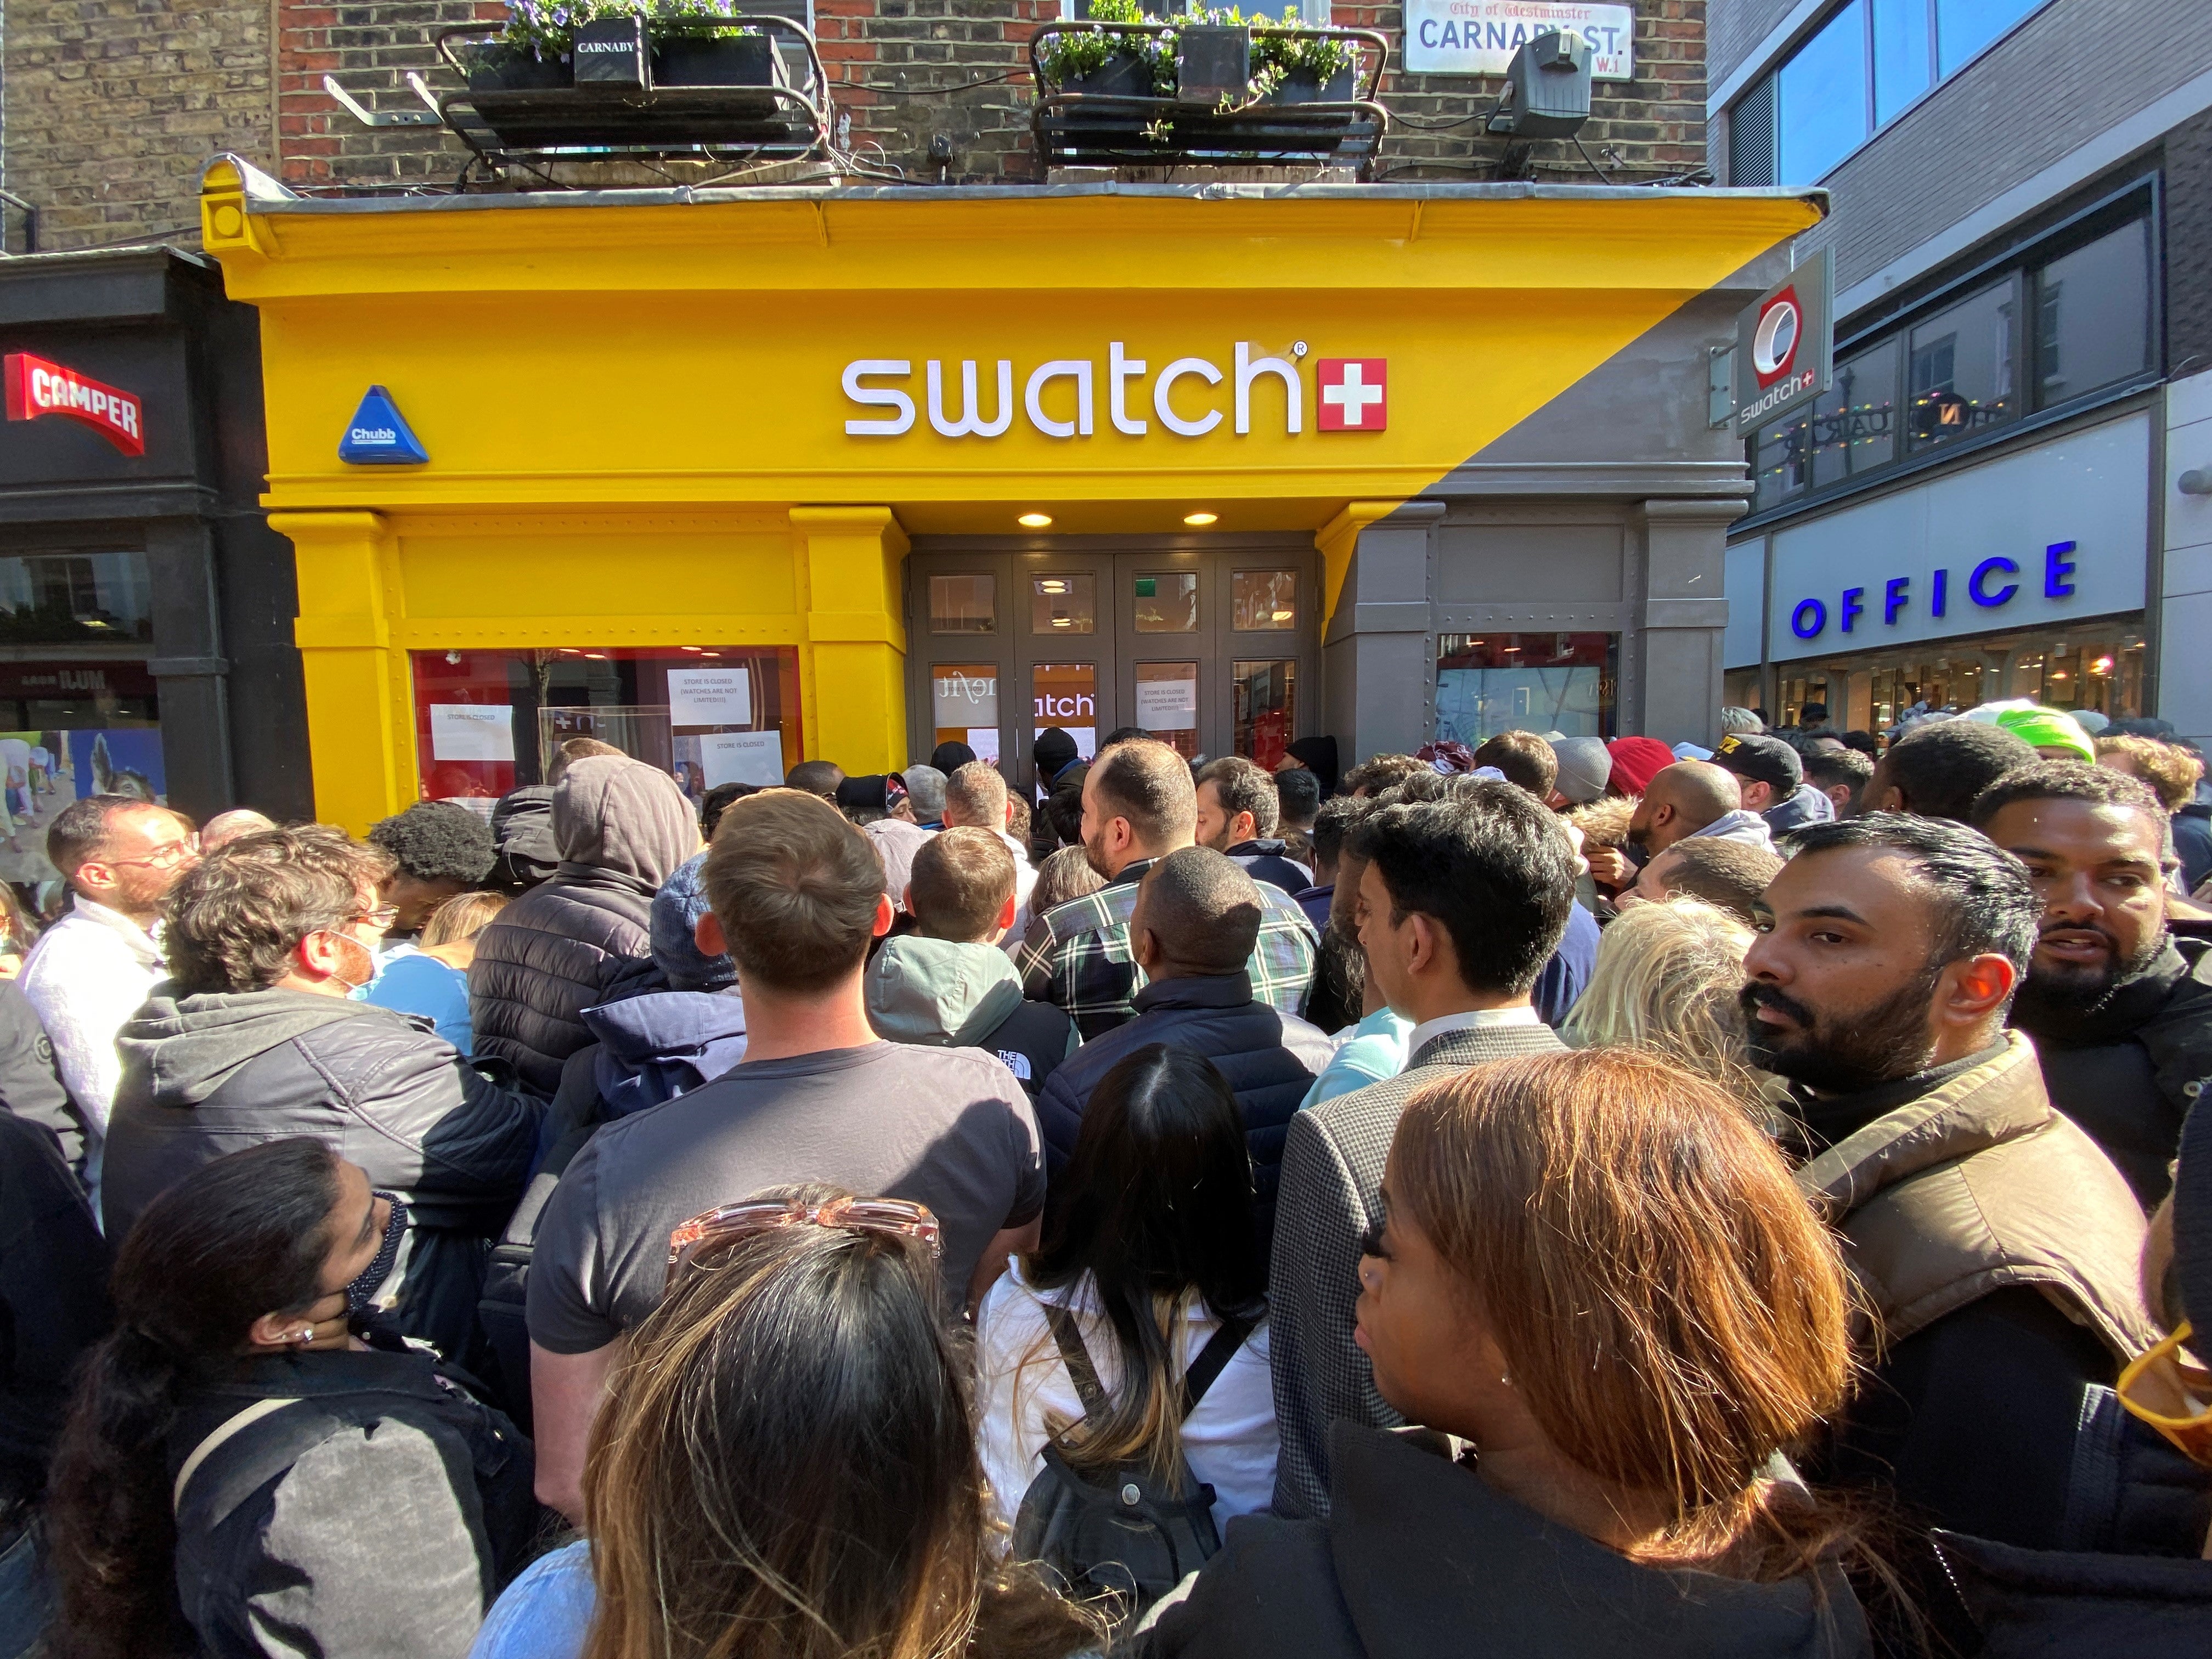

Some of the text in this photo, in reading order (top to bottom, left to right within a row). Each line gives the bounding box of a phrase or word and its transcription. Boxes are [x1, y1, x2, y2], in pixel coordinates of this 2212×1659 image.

[1450, 1, 1592, 21] City of Westminster
[1420, 19, 1622, 55] CARNA ST.
[578, 42, 635, 53] CARNABY
[1596, 57, 1620, 73] W.1
[32, 368, 139, 439] CAMPER
[1741, 376, 1802, 425] swatch
[351, 428, 397, 439] Chubb
[1792, 540, 2076, 639] OFFICE
[997, 1049, 1017, 1060] THE
